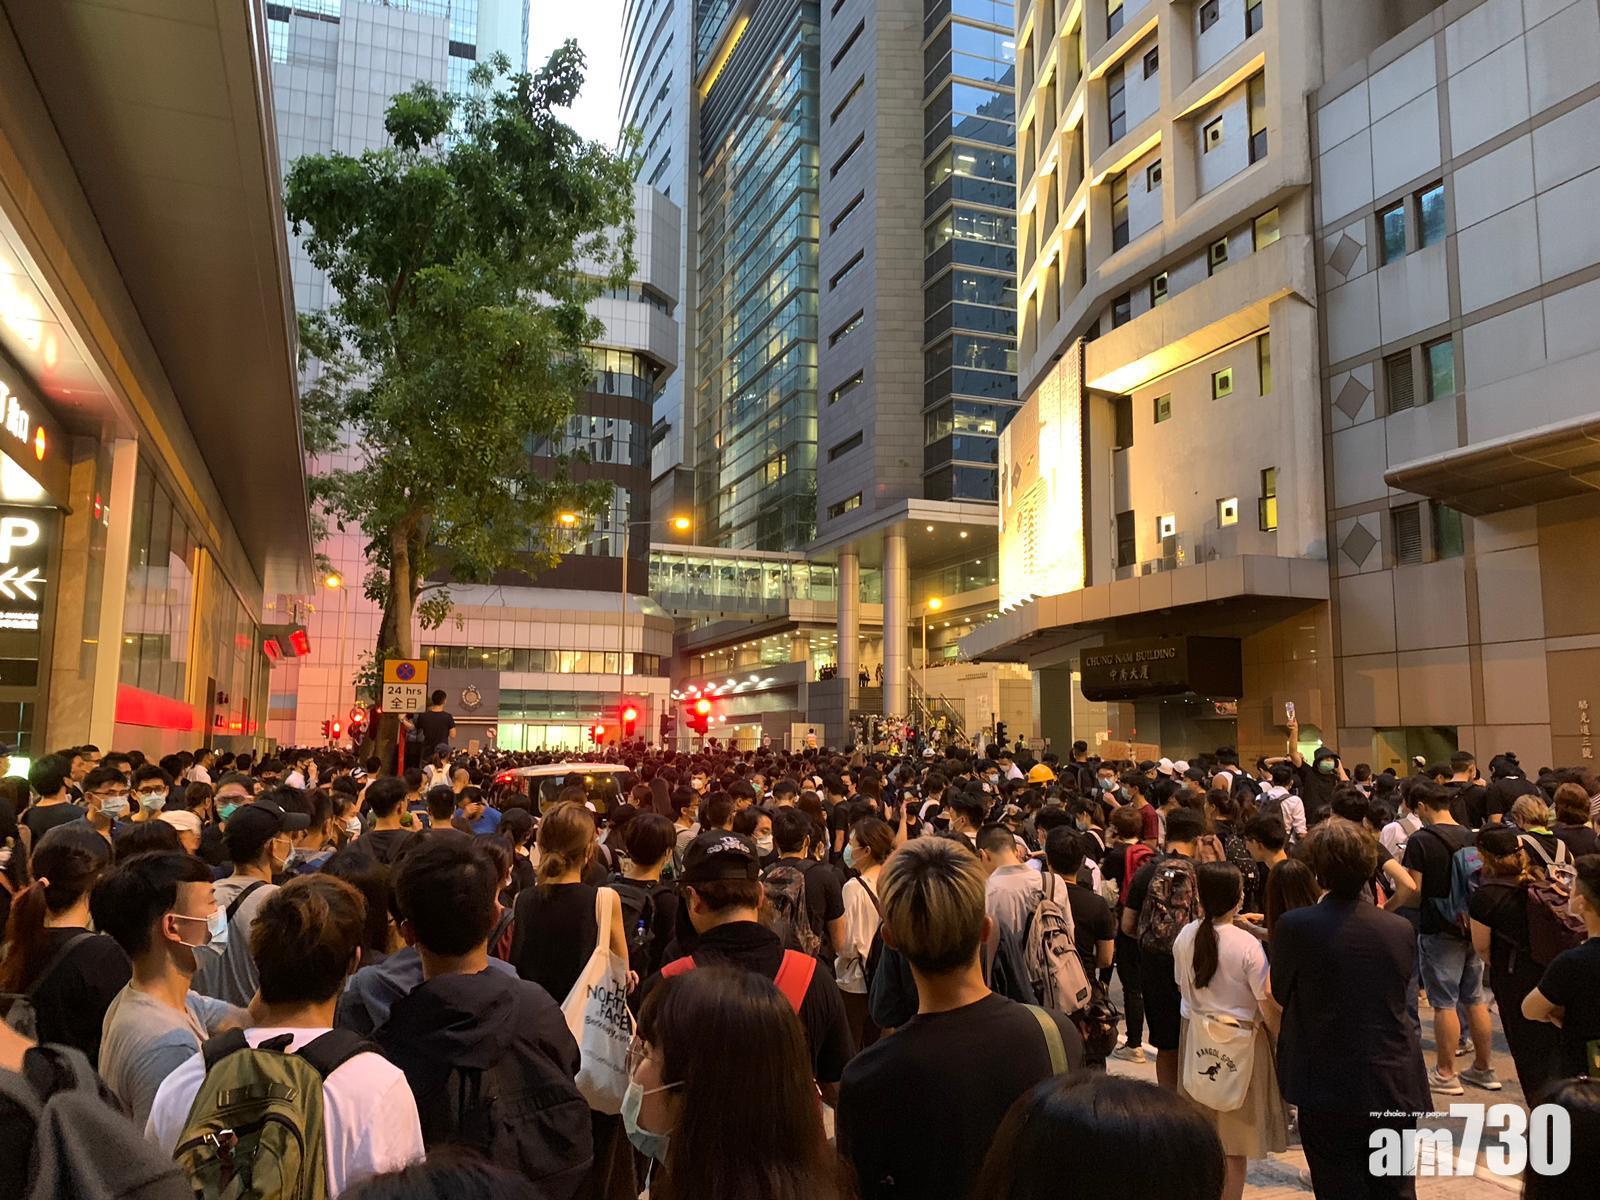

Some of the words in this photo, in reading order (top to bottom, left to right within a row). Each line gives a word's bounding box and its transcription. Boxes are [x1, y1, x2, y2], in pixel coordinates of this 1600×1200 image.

[1086, 654, 1113, 667] CHUNG
[1115, 652, 1133, 664] NAM
[1135, 647, 1175, 662] BUILDING
[387, 686, 402, 695] 24
[406, 686, 422, 695] hrs
[390, 697, 417, 709] 全日
[599, 1003, 629, 1031] FACE
[1196, 1048, 1220, 1058] KANGOL
[1220, 1054, 1238, 1072] SPORT
